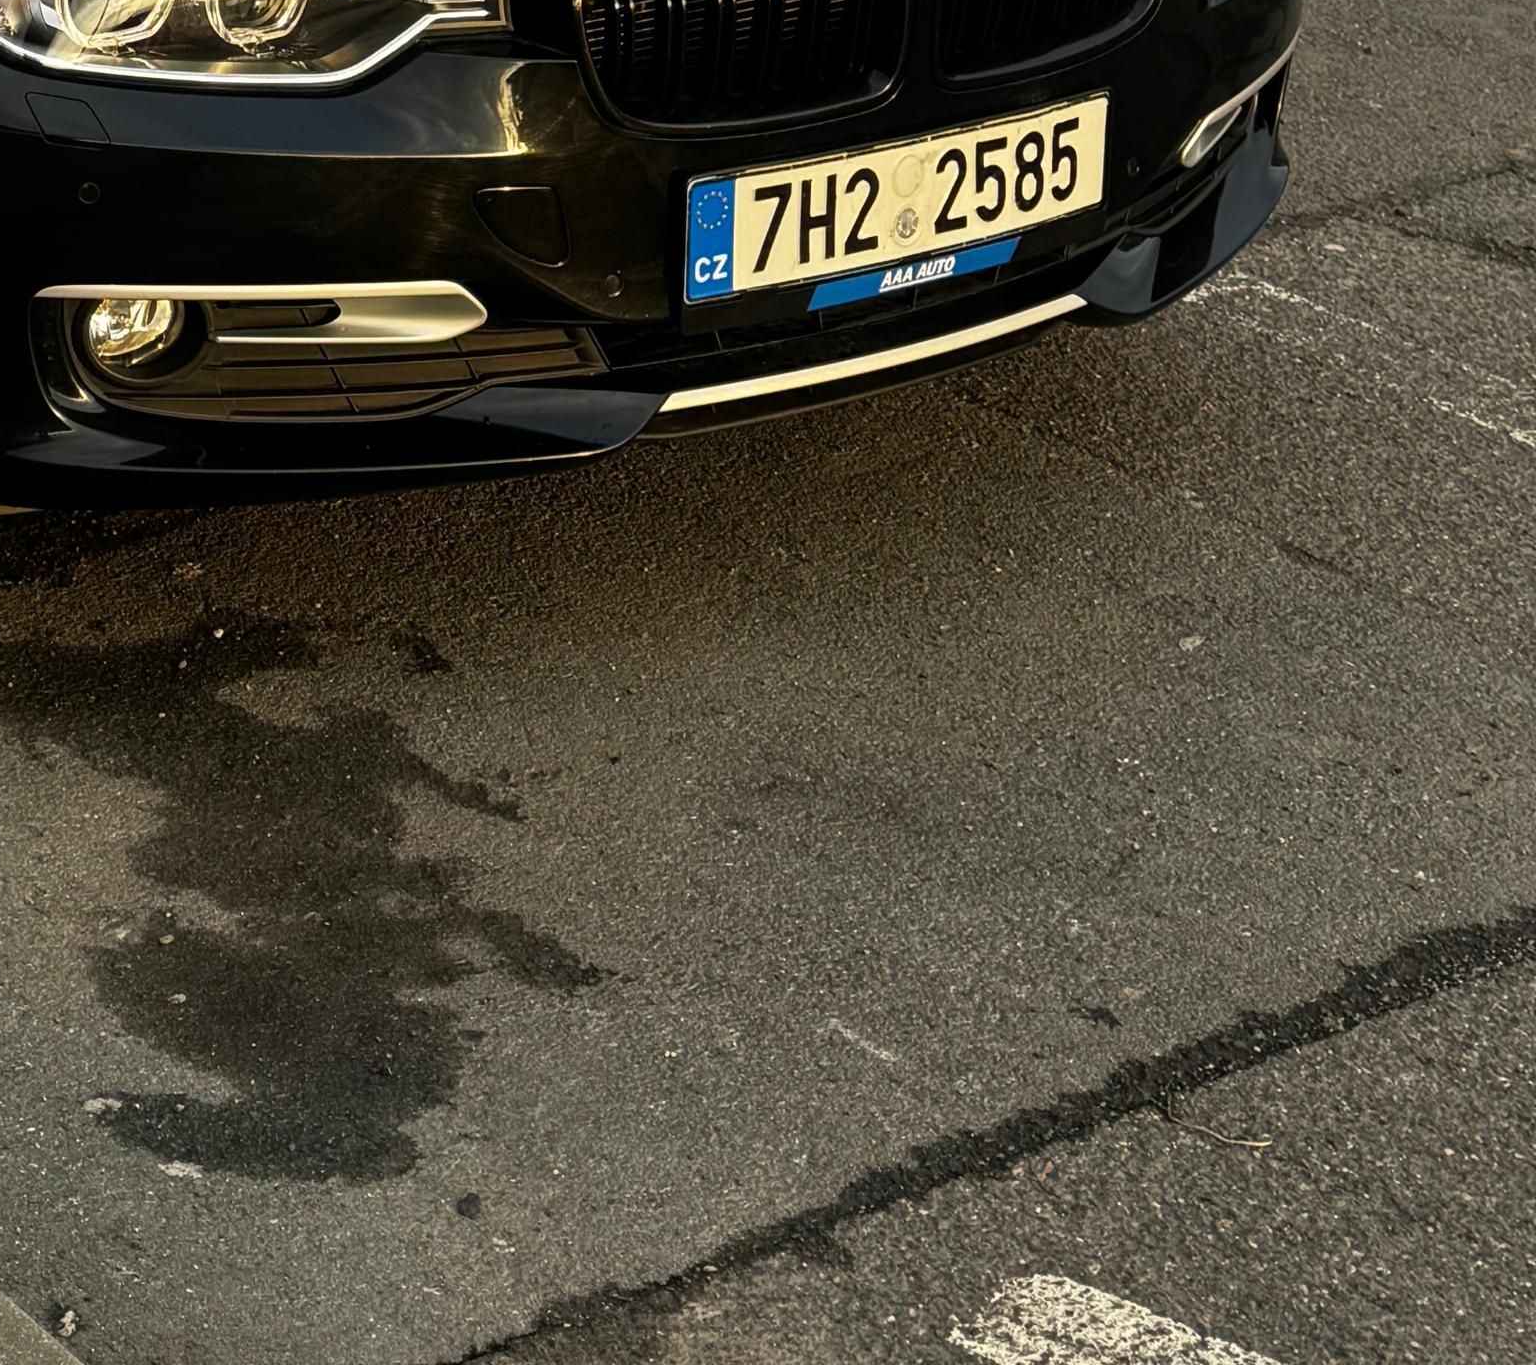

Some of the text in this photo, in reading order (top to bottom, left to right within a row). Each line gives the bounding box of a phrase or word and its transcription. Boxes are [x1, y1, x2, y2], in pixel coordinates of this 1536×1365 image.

[753, 117, 1079, 273] 7H2 2585
[695, 253, 728, 283] CZ
[880, 254, 956, 288] AAA AUTO
